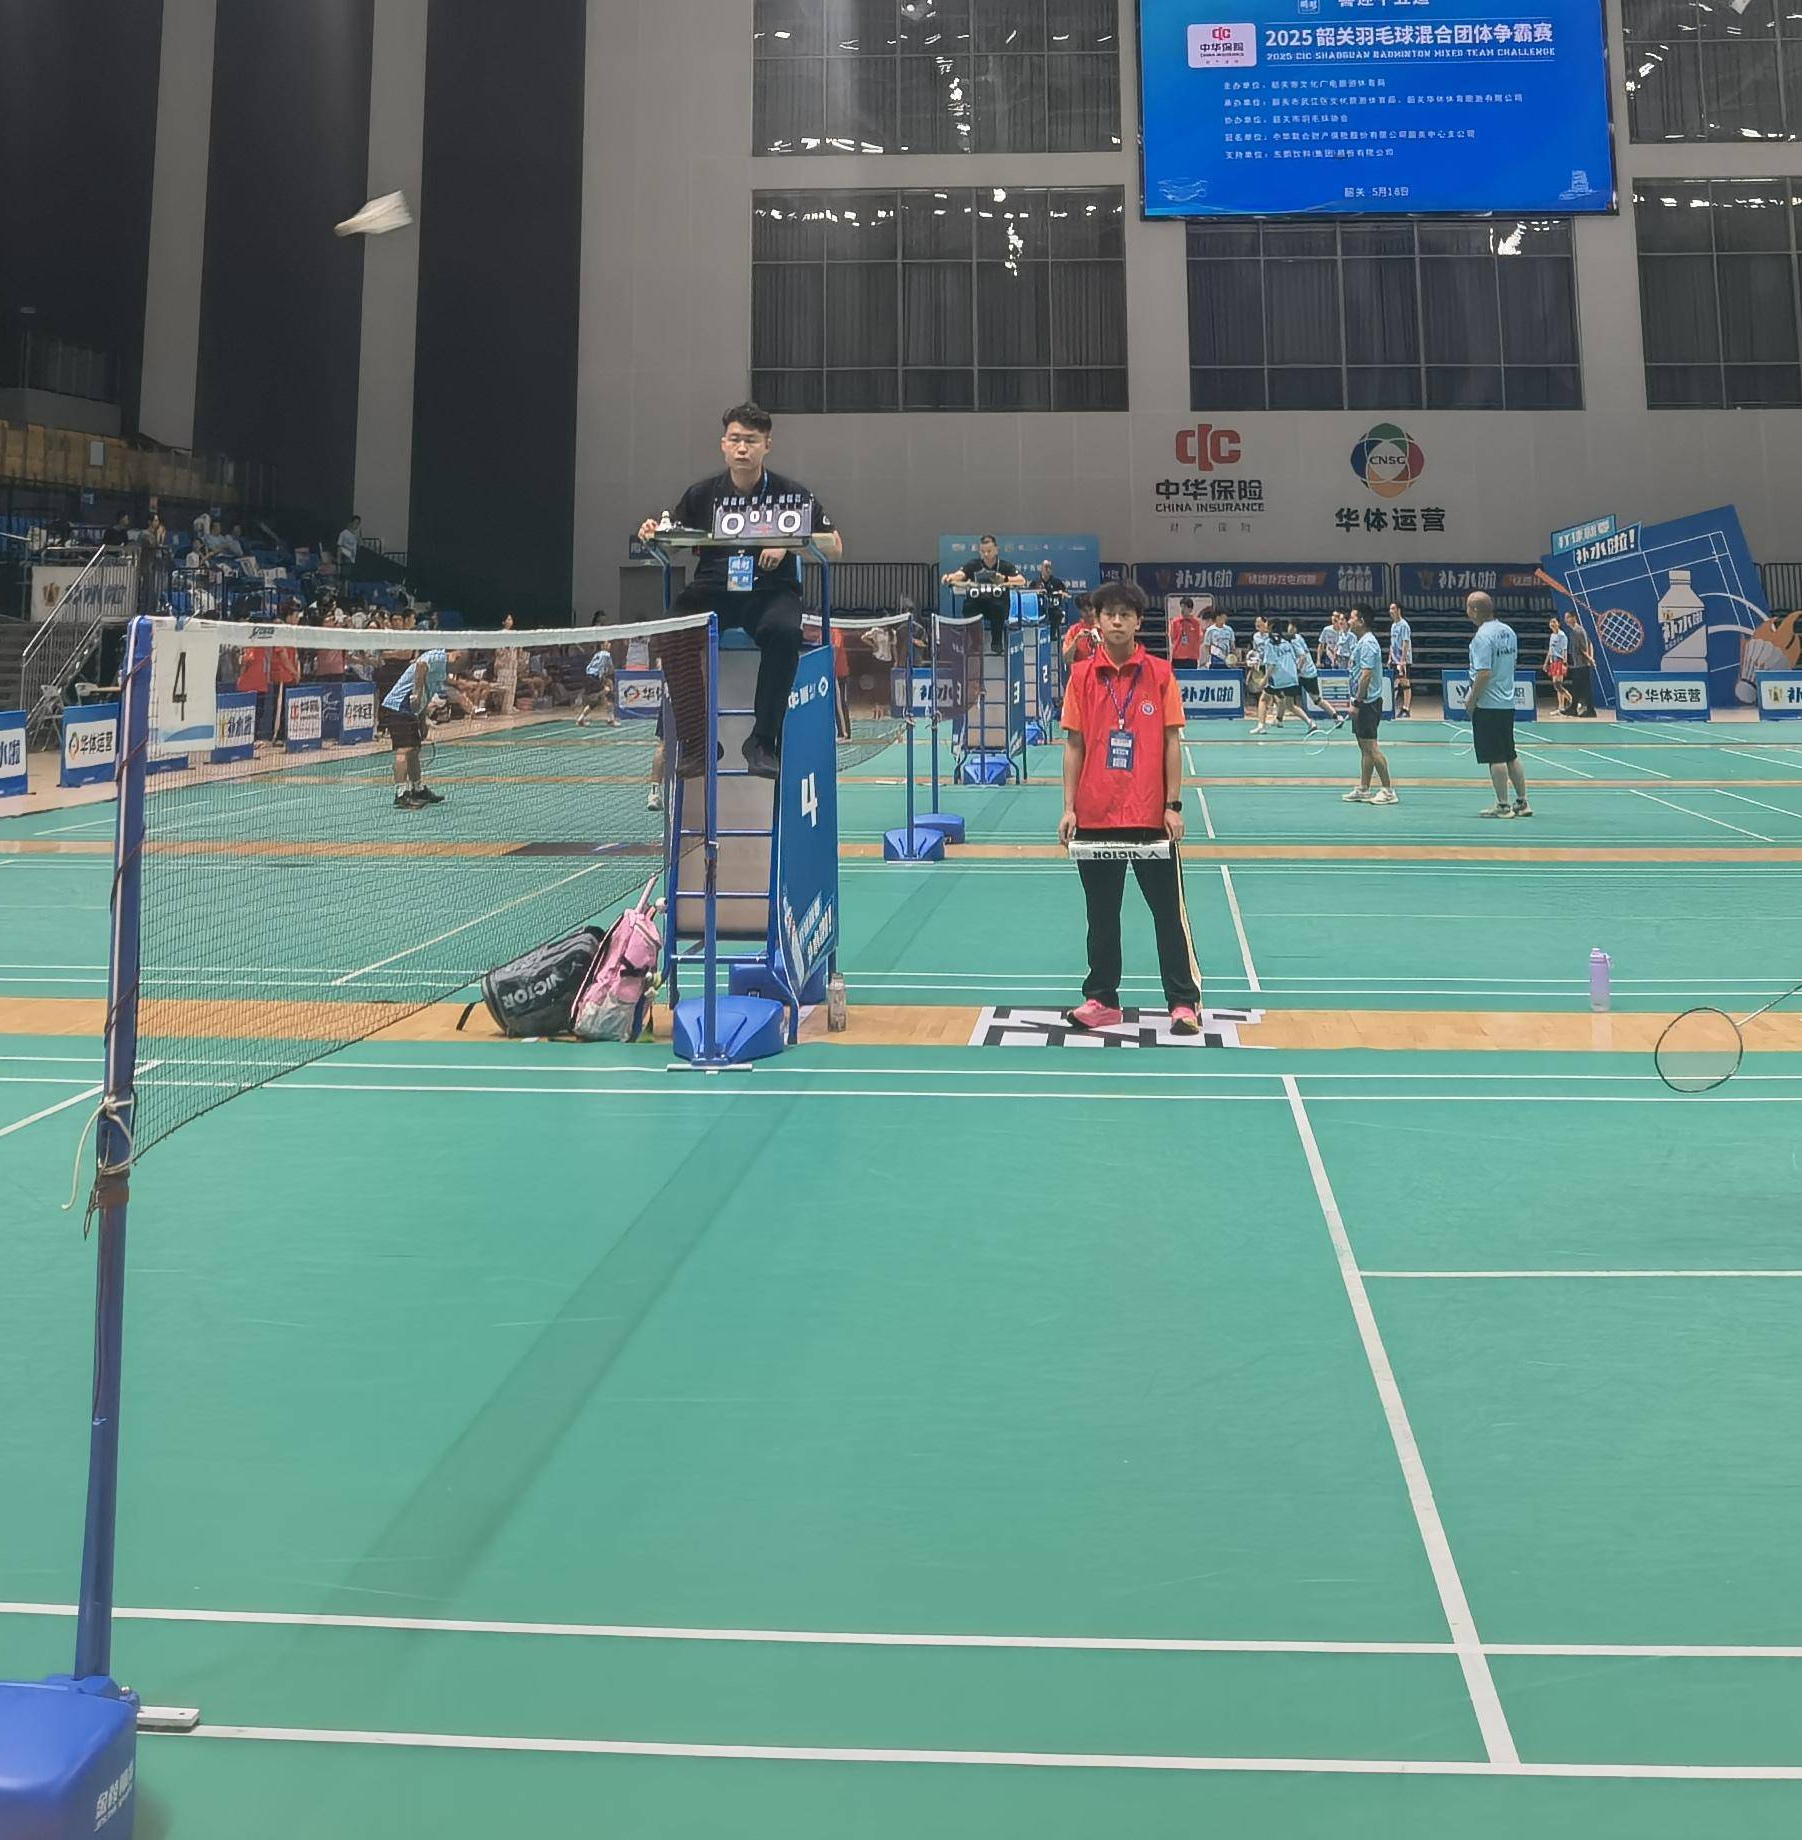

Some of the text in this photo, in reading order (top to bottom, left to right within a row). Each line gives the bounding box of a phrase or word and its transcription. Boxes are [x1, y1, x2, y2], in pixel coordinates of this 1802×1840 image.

[1466, 48, 1494, 57] TEAM
[1155, 478, 1264, 501] 中华保险
[1154, 502, 1265, 513] CHINA INSURANCE
[722, 512, 745, 535] 0
[778, 510, 801, 533] 0
[1335, 506, 1446, 533] 华体运营
[1575, 528, 1636, 564] 补水啦!
[1175, 568, 1233, 589] 补水啦
[1438, 569, 1497, 590] 补水啦
[172, 650, 188, 722] 4
[1181, 685, 1234, 703] 补水啦
[1645, 687, 1701, 703] 华体运营
[79, 730, 114, 754] 华体运营
[800, 772, 818, 828] 4
[1092, 850, 1143, 860] VICTOR
[500, 972, 564, 1010] VICTOR
